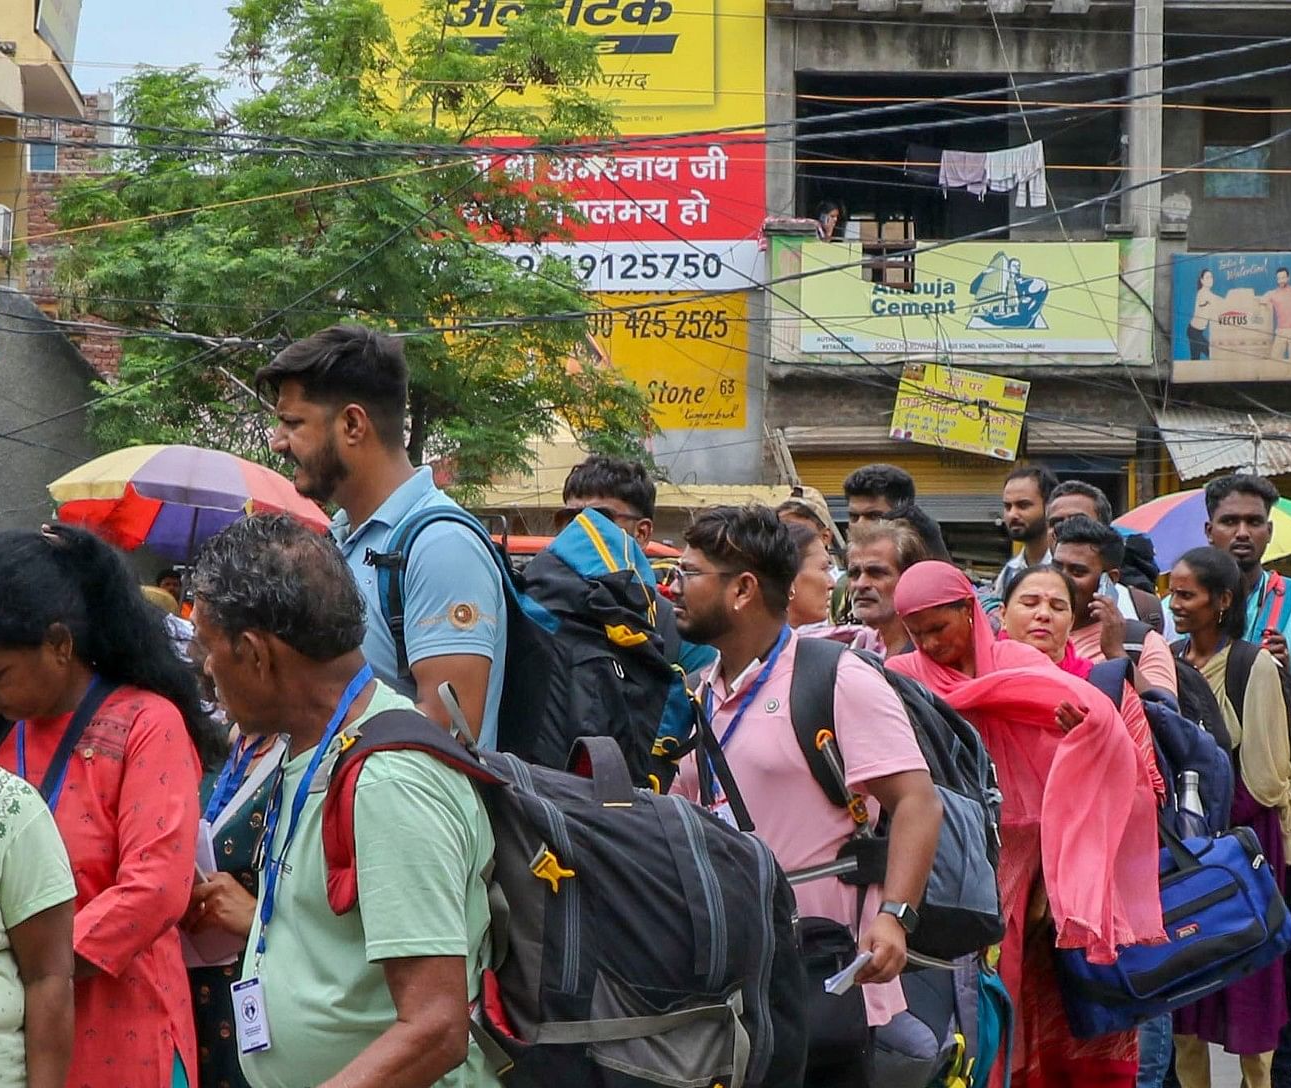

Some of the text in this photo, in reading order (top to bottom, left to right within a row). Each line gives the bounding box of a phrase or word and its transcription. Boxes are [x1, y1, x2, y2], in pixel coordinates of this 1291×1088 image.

[602, 69, 650, 90] पसंद
[548, 154, 680, 183] अमरनाथ
[688, 145, 729, 181] जी
[678, 189, 710, 225] हो
[871, 298, 956, 316] Cement
[624, 309, 729, 339] 425 2525
[1218, 315, 1248, 326] VECTUS
[875, 342, 898, 351] SOOD
[719, 378, 735, 395] 63
